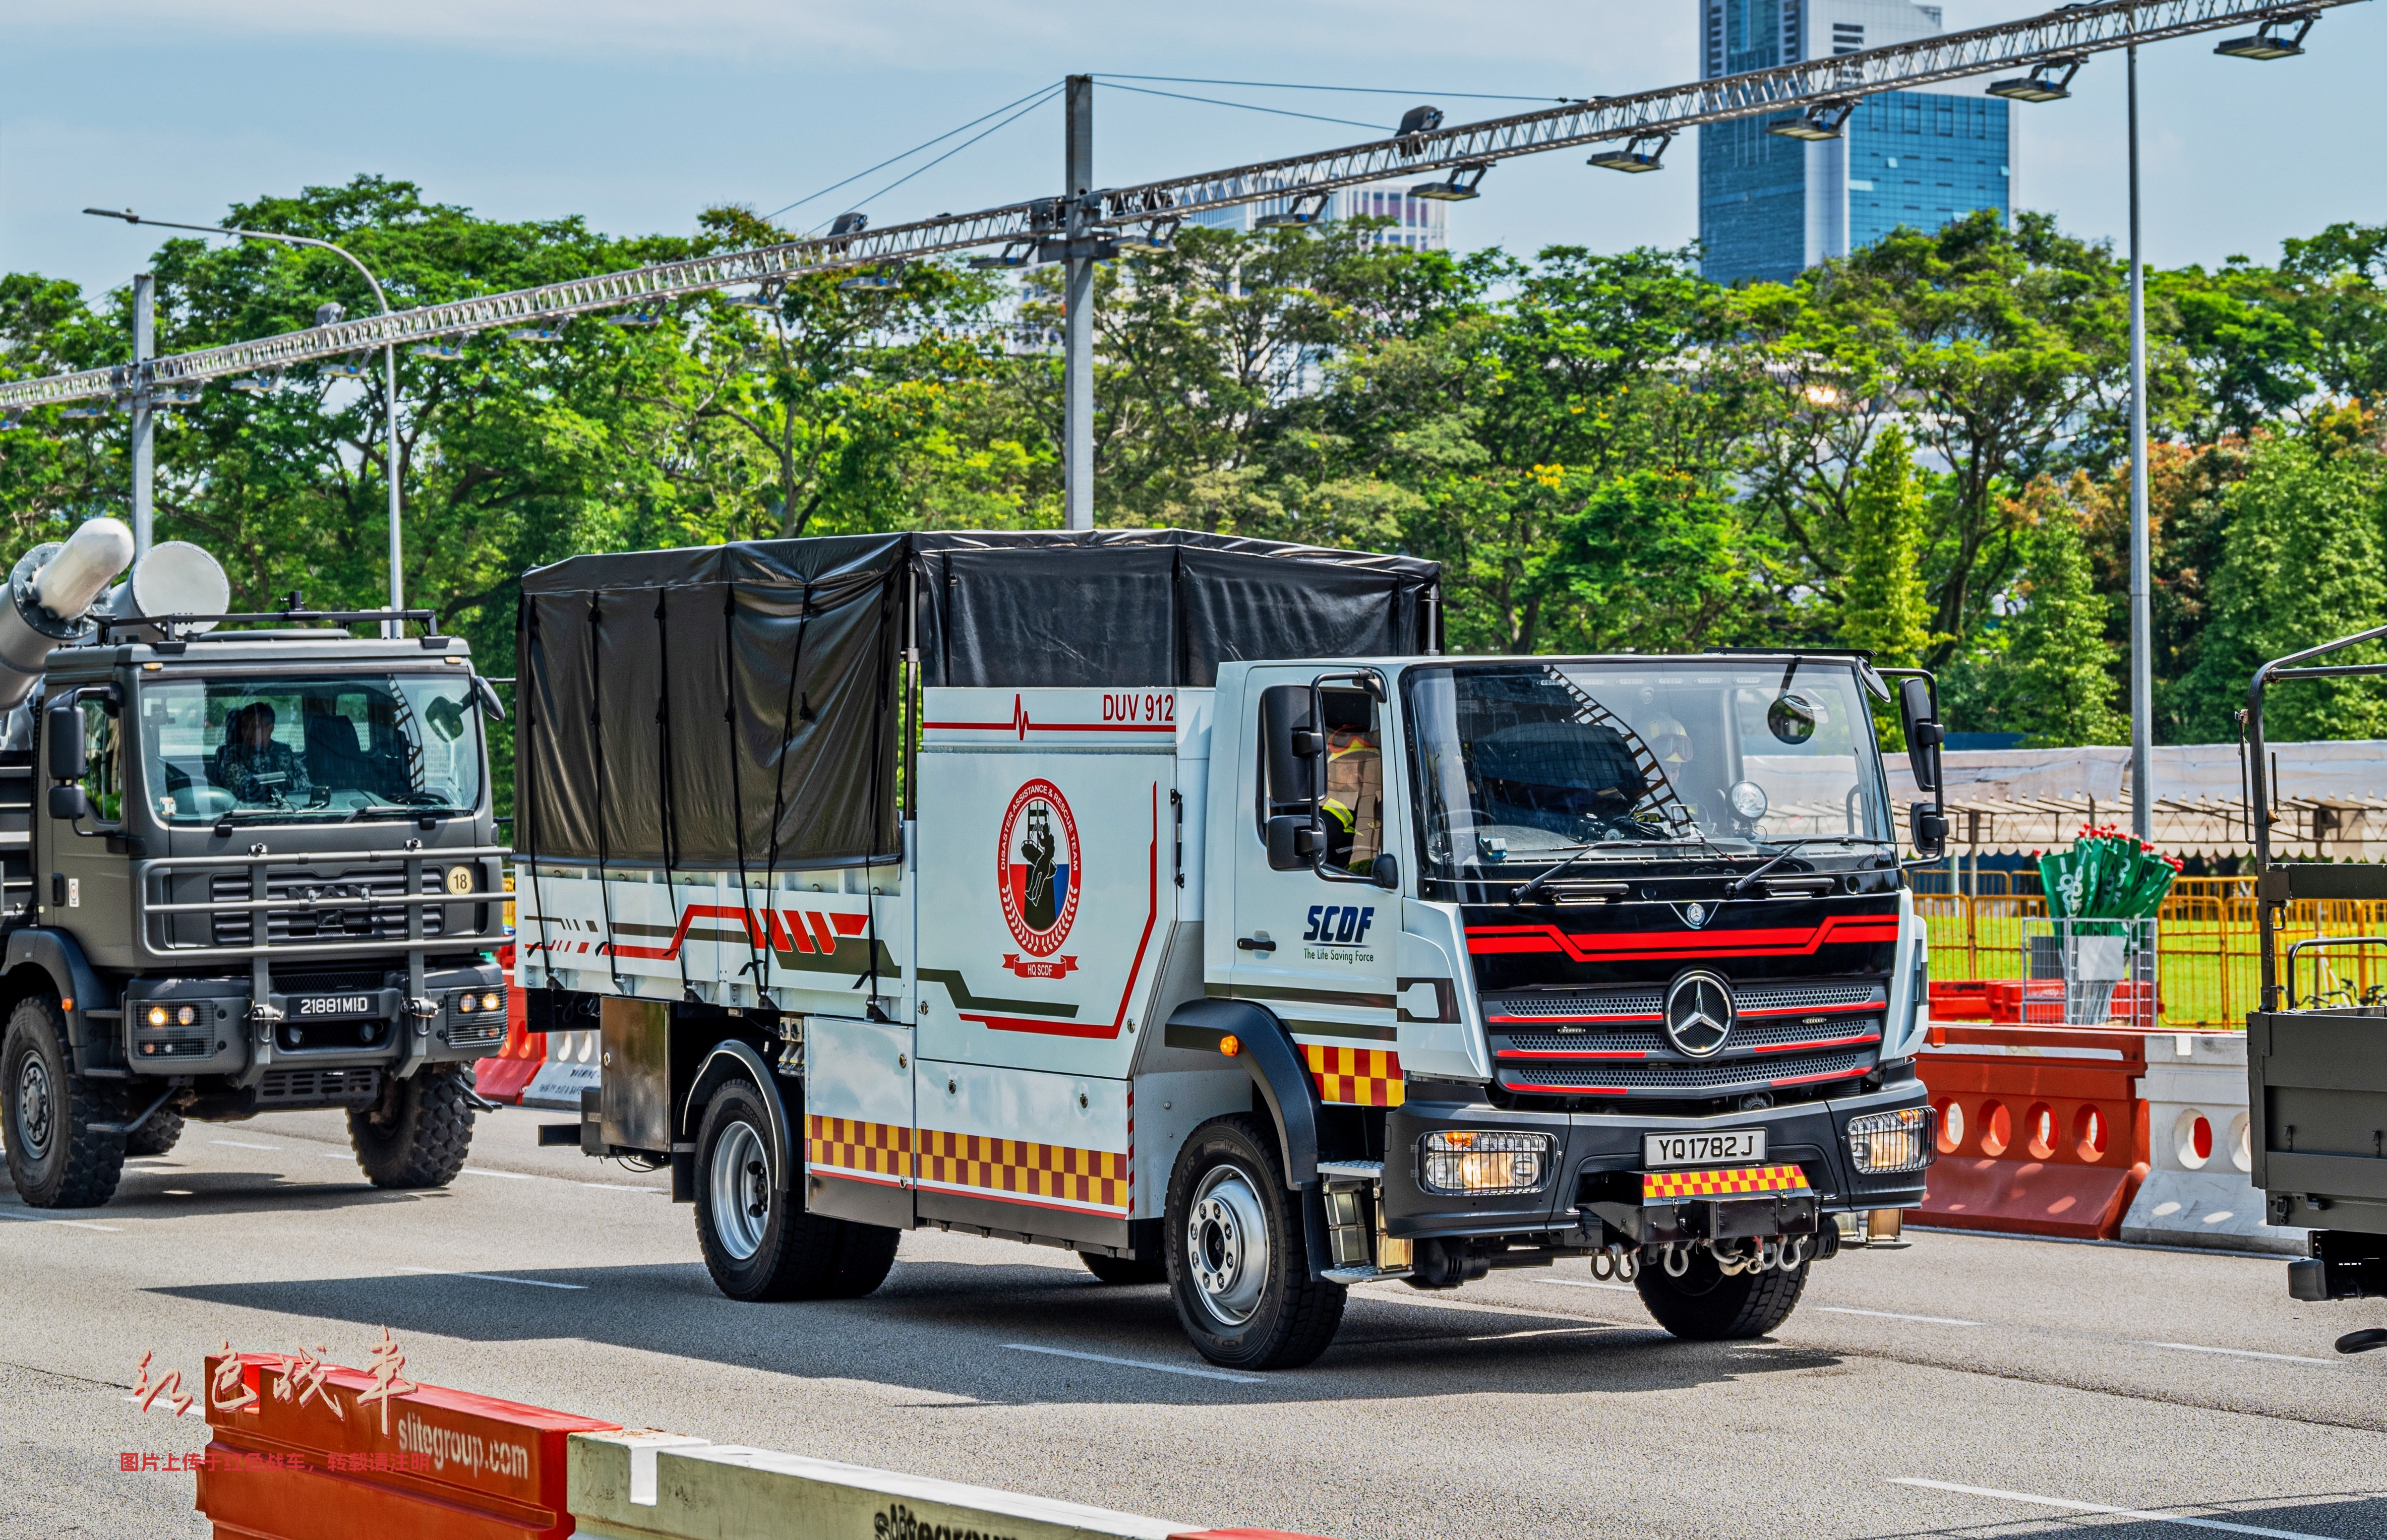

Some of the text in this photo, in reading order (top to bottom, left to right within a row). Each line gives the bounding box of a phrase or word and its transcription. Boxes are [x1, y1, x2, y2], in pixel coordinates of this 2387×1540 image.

[1103, 694, 1174, 721] DUV 912
[1001, 784, 1078, 871] DISASTER ASSISTANCE & RESCUE TEAM
[288, 884, 372, 900] MAN
[452, 874, 467, 890] 18
[1303, 905, 1375, 943] SCDF
[1304, 948, 1374, 964] The Life Saving Force
[1027, 964, 1053, 976] HQ SCDF
[301, 997, 368, 1014] 21881MID
[1658, 1135, 1754, 1160] YQ1782J
[398, 1411, 528, 1480] slitegroup.com
